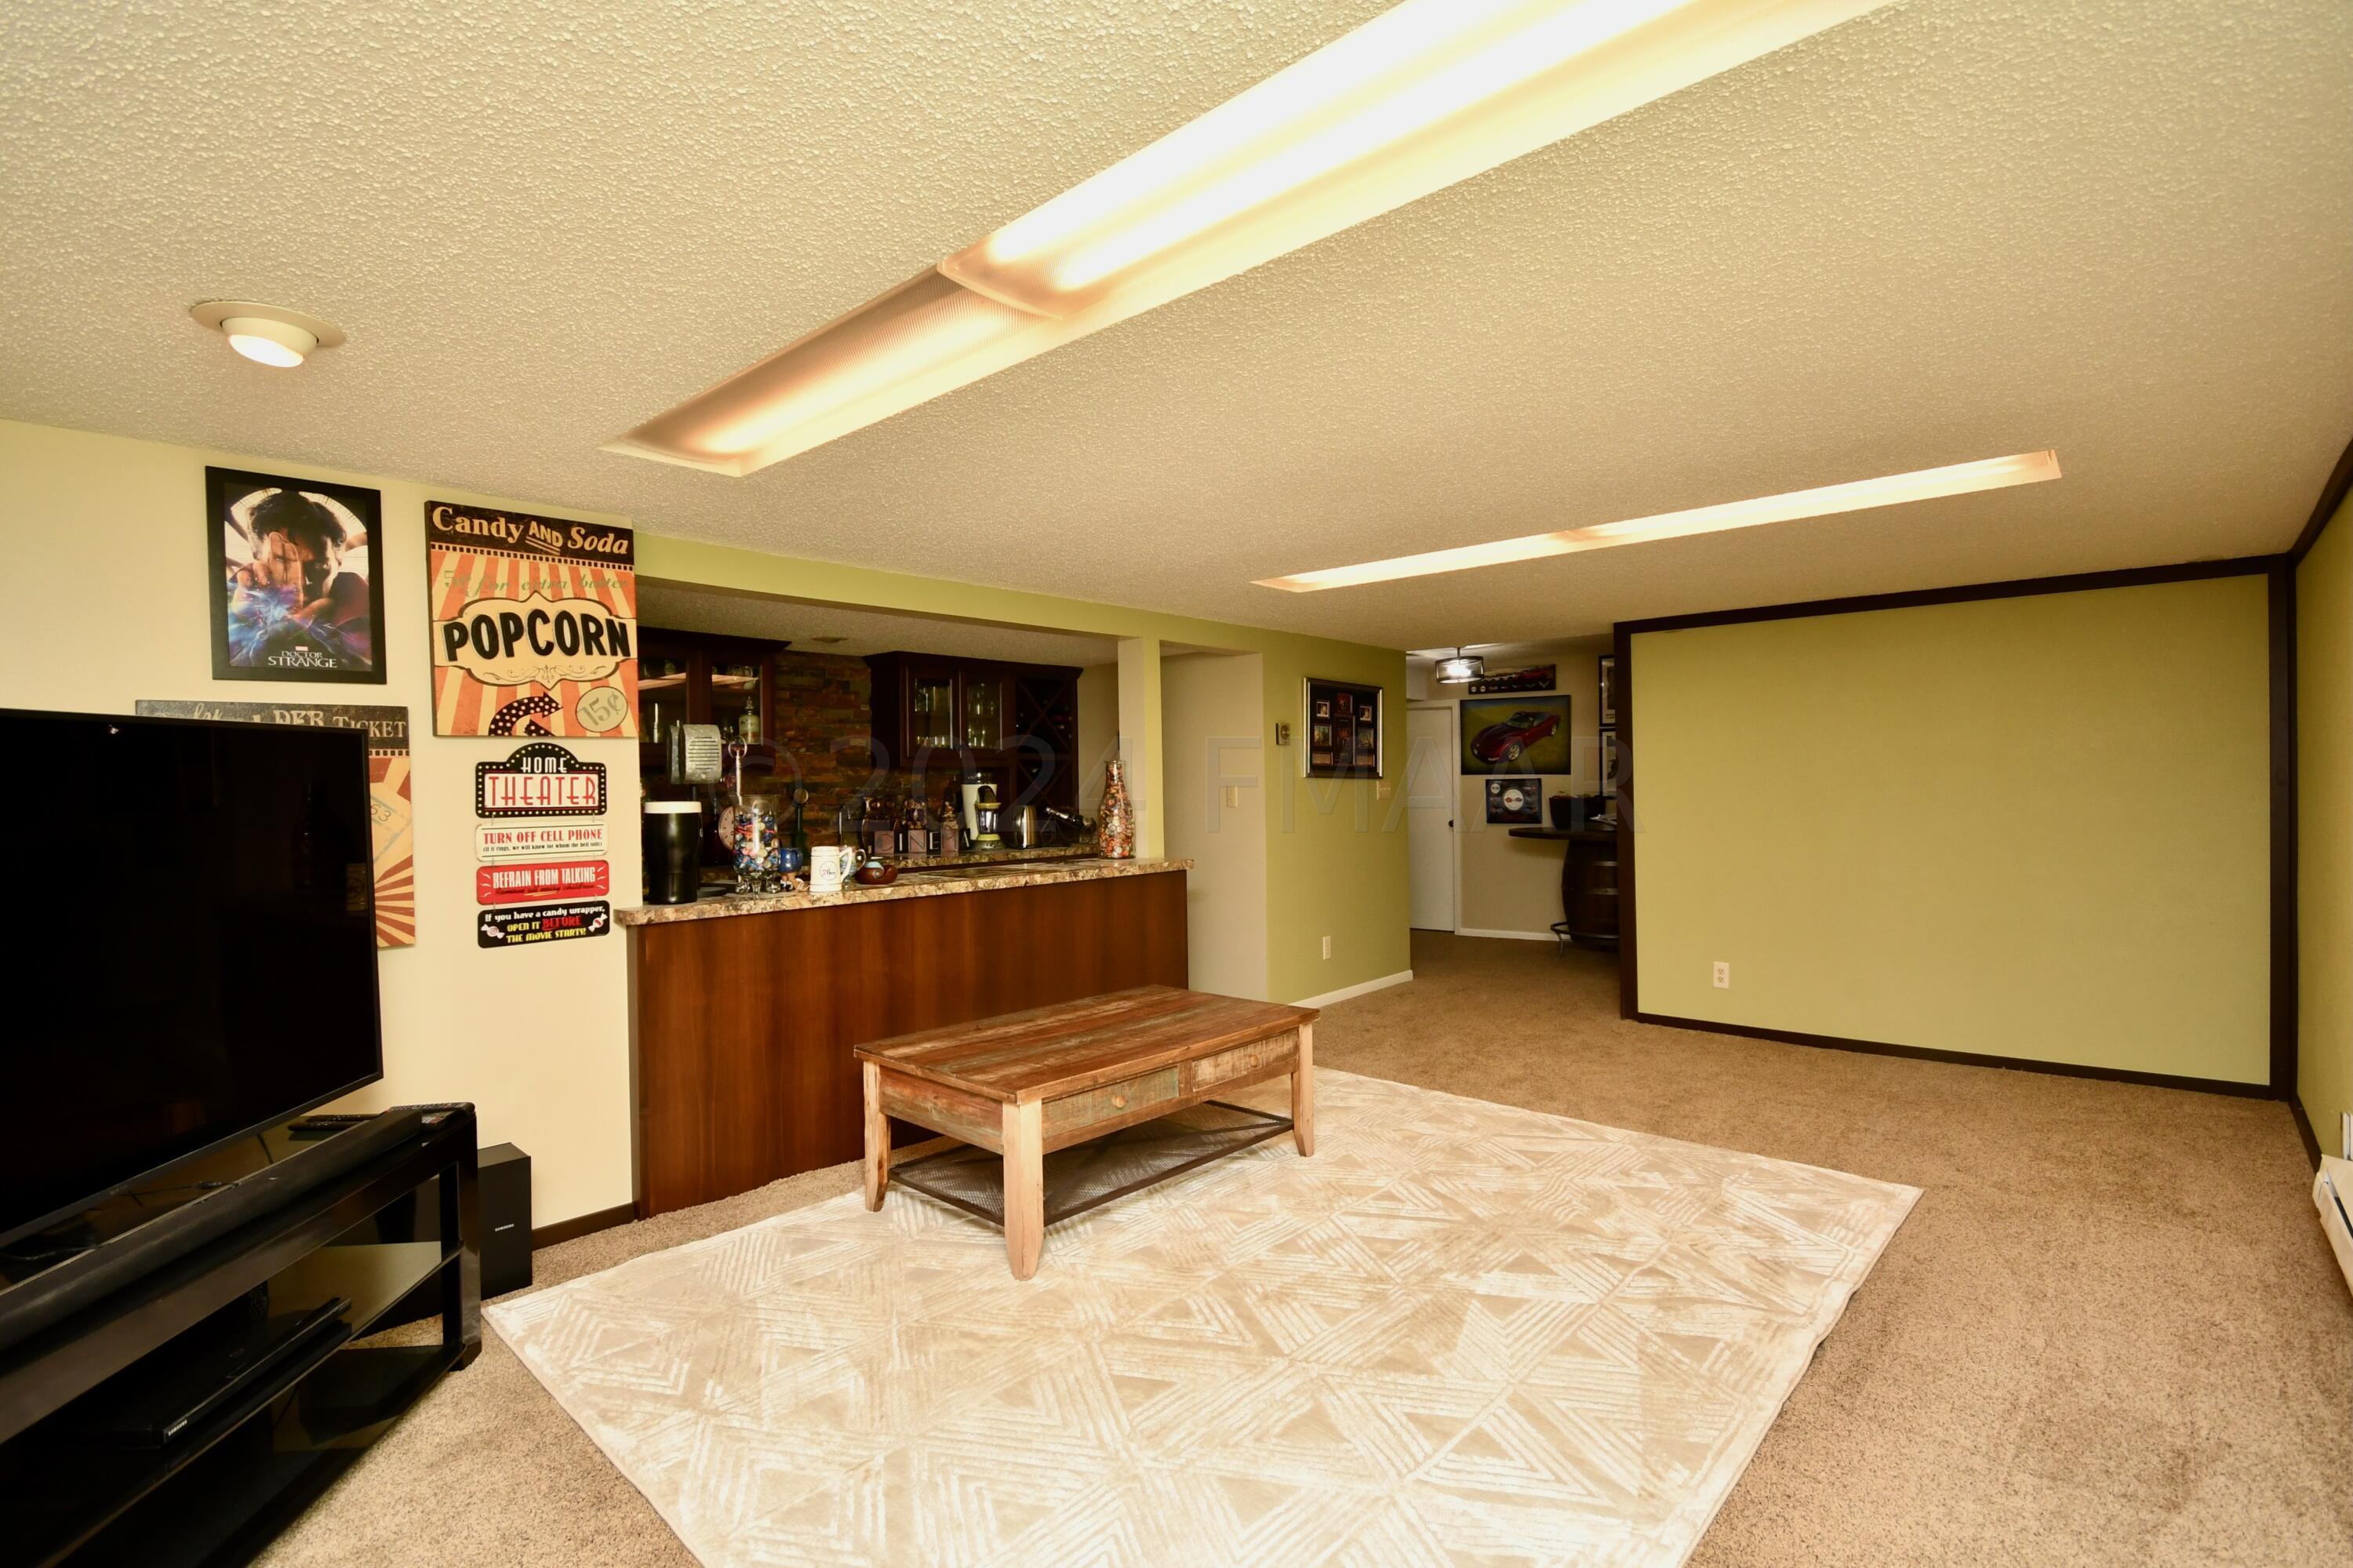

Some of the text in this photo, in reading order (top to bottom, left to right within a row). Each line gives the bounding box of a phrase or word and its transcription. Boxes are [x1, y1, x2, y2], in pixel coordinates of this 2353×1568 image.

[432, 506, 629, 555] Candy AND Soda
[441, 608, 631, 662] POPCORN
[267, 656, 338, 668] STRANGE
[282, 650, 323, 659] DOCTOR
[577, 691, 621, 727] 15¢
[521, 756, 567, 773] HOME
[488, 776, 596, 806] THEATER
[483, 828, 602, 845] TURN OFF CELL PHONE
[493, 867, 596, 889] REFRAIN FROM TALKING
[494, 914, 511, 922] you
[542, 908, 567, 916] candy
[569, 906, 606, 915] wrapper,
[507, 915, 582, 932] OPEN IT BEFORE
[506, 927, 587, 943] THE MOVIE STARTS!
